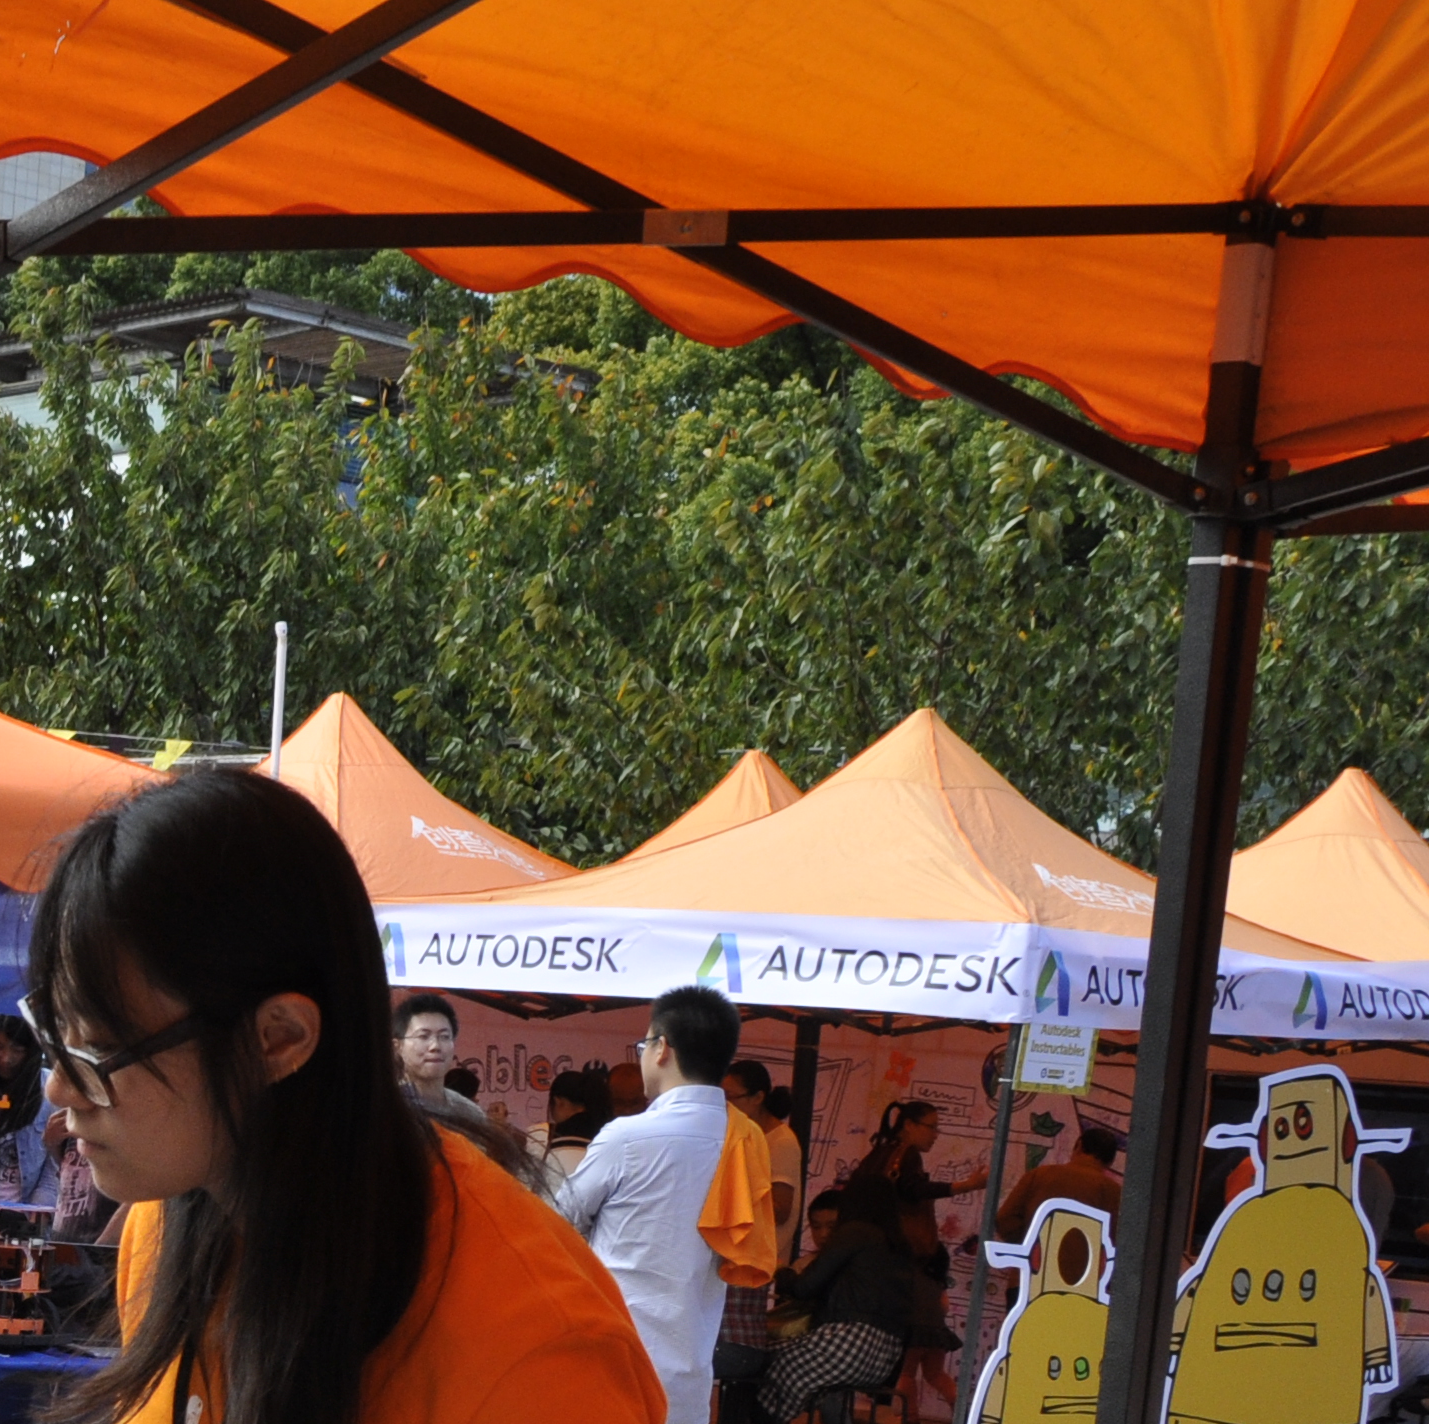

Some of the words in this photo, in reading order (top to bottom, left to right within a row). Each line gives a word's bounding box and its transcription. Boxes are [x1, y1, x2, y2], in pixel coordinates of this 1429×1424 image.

[418, 932, 624, 974] AUTODESK
[758, 944, 1024, 998] AUTODESK
[1041, 1023, 1081, 1038] Autodesk
[1030, 1040, 1085, 1057] Instructables
